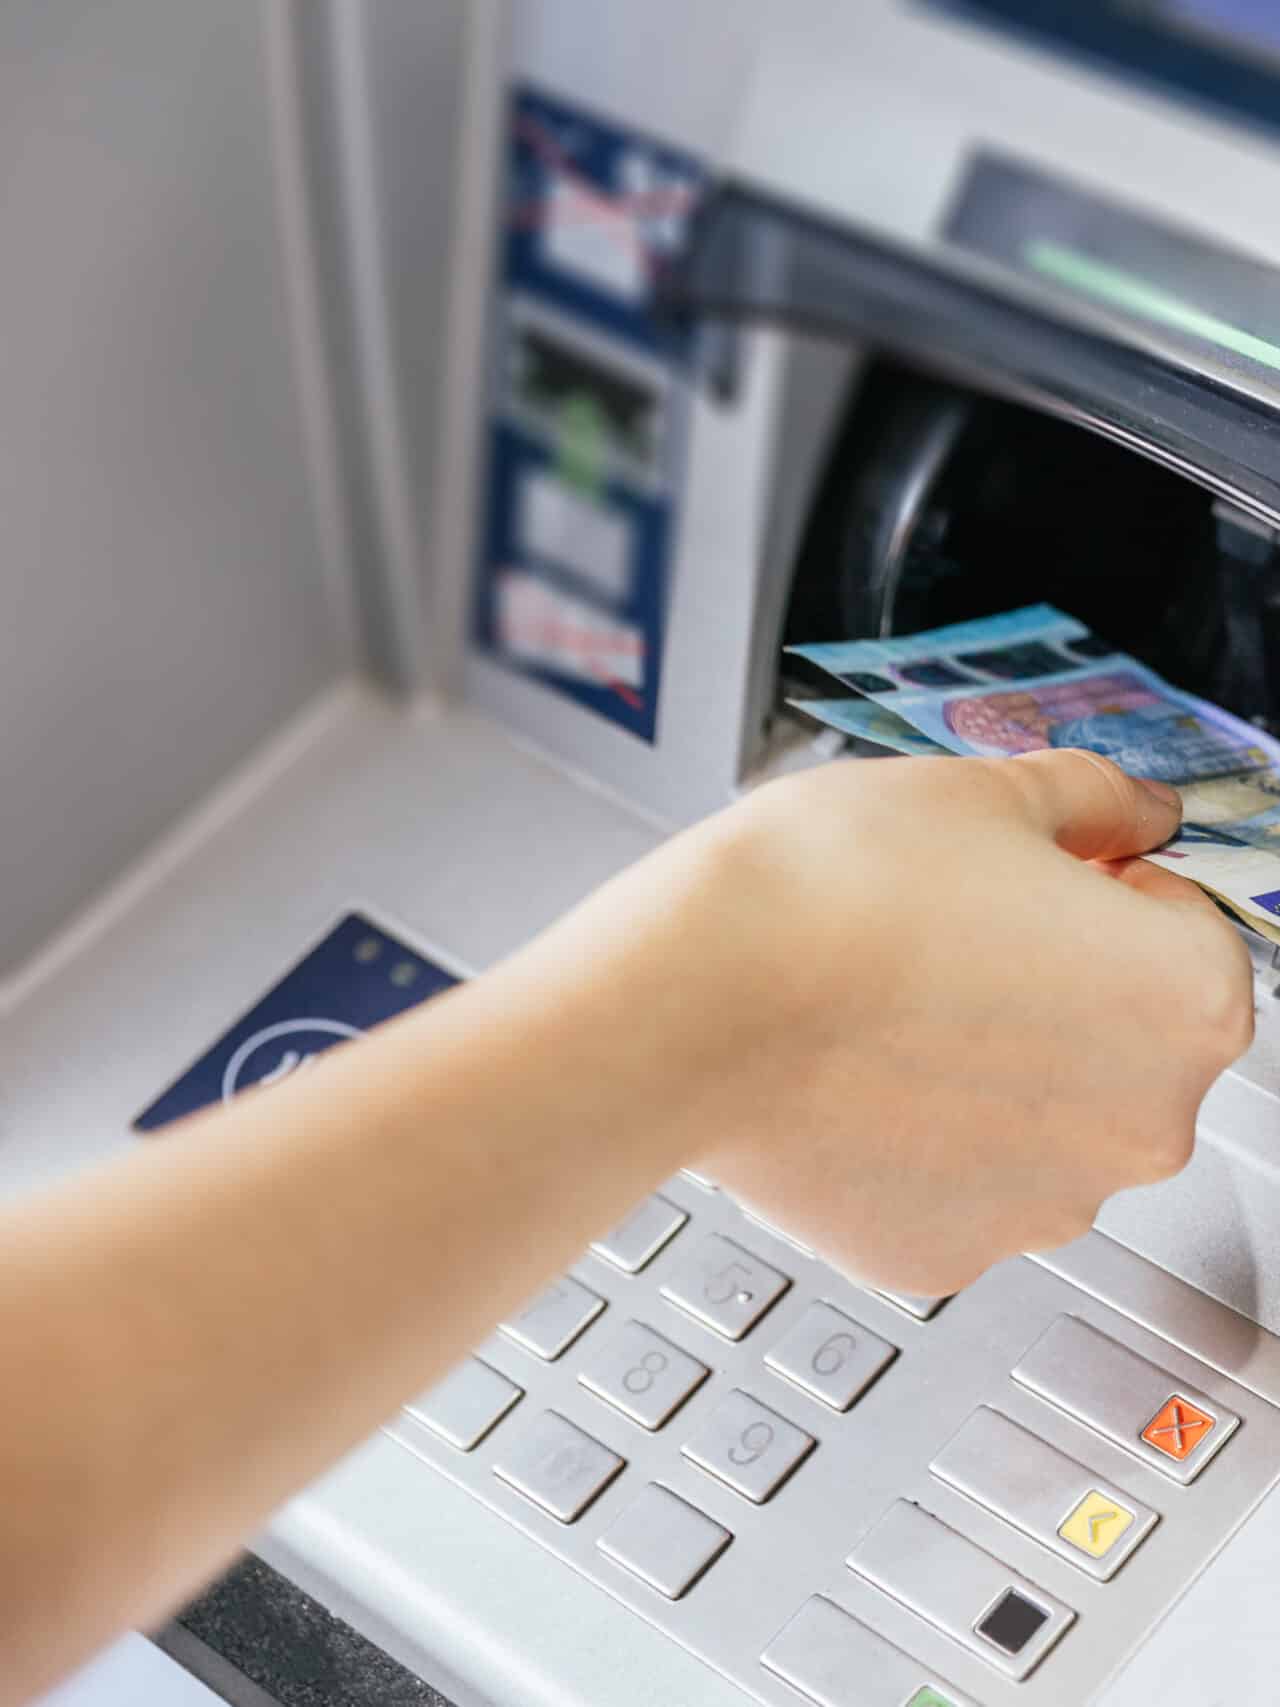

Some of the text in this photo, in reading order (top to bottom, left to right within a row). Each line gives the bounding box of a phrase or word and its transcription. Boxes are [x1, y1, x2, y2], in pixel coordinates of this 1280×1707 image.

[704, 1262, 752, 1304] 5
[622, 1352, 668, 1394] 8
[811, 1332, 856, 1376] 6
[727, 1422, 774, 1465] 9
